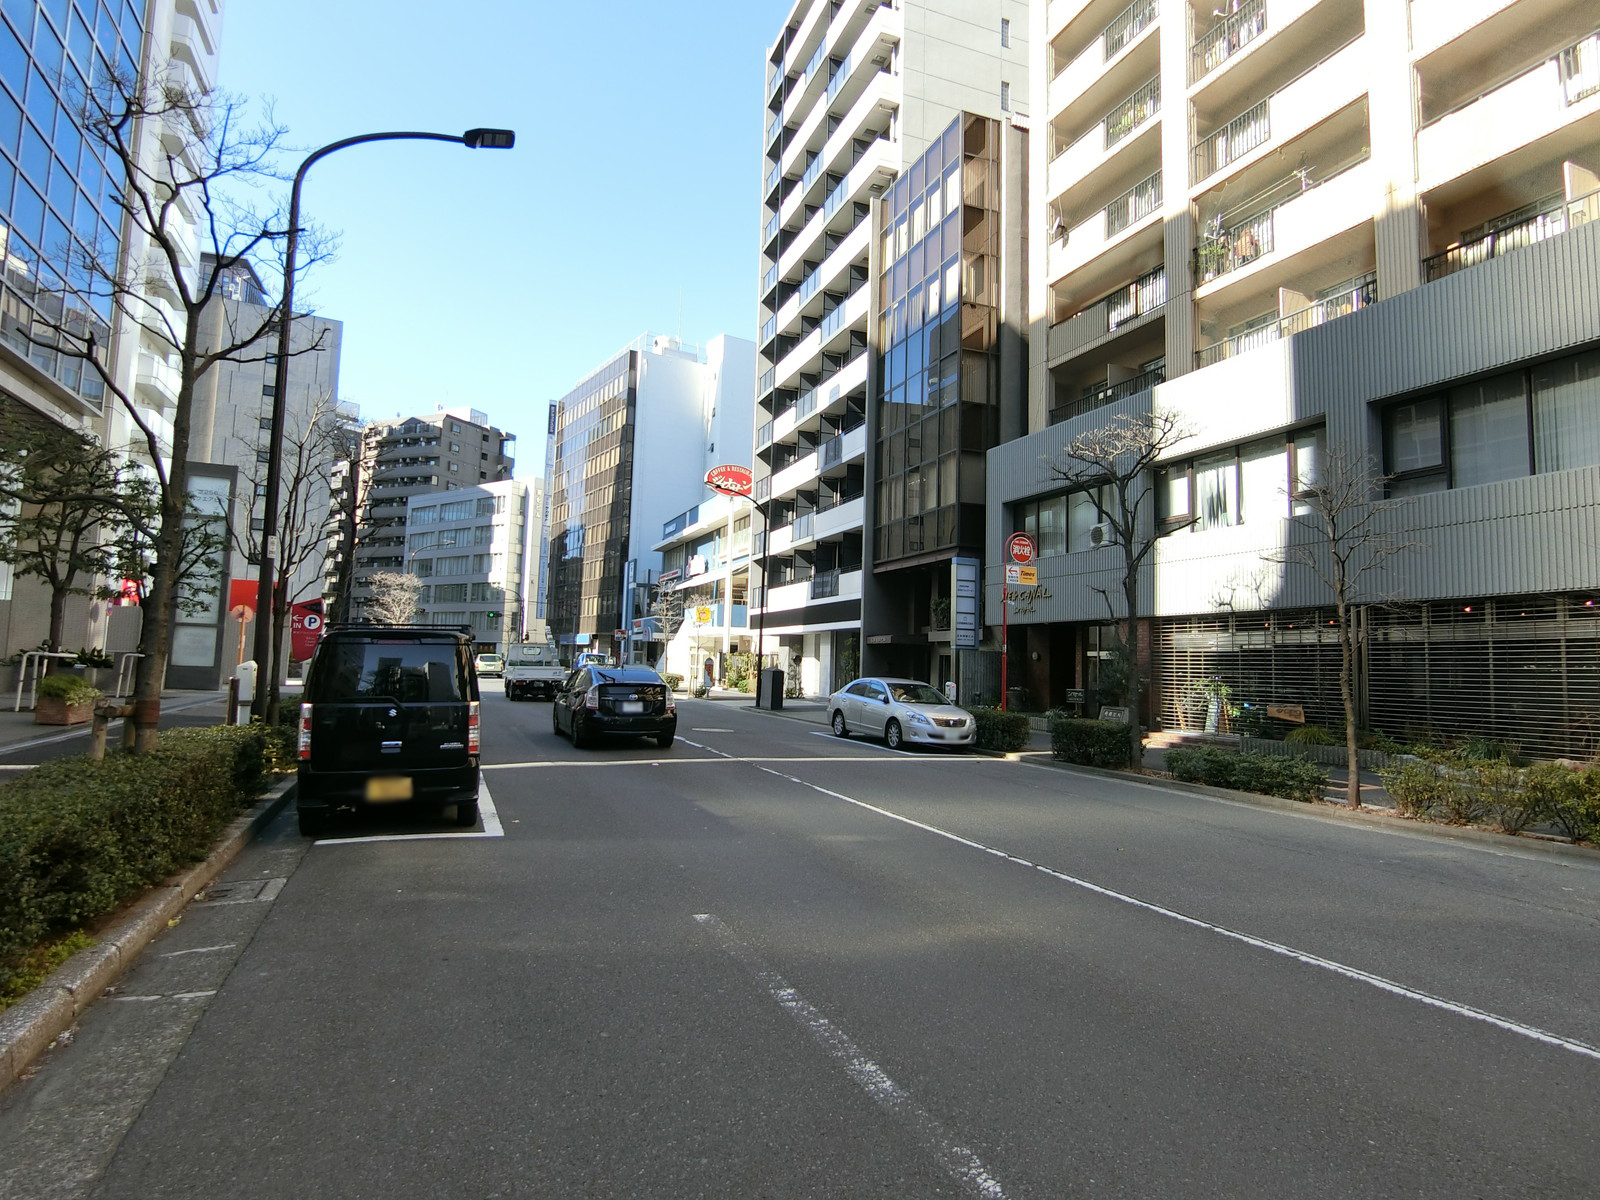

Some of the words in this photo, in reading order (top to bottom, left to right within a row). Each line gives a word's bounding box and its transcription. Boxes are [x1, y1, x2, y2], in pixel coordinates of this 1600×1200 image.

[1012, 544, 1031, 556] 消火栓
[308, 617, 317, 627] P
